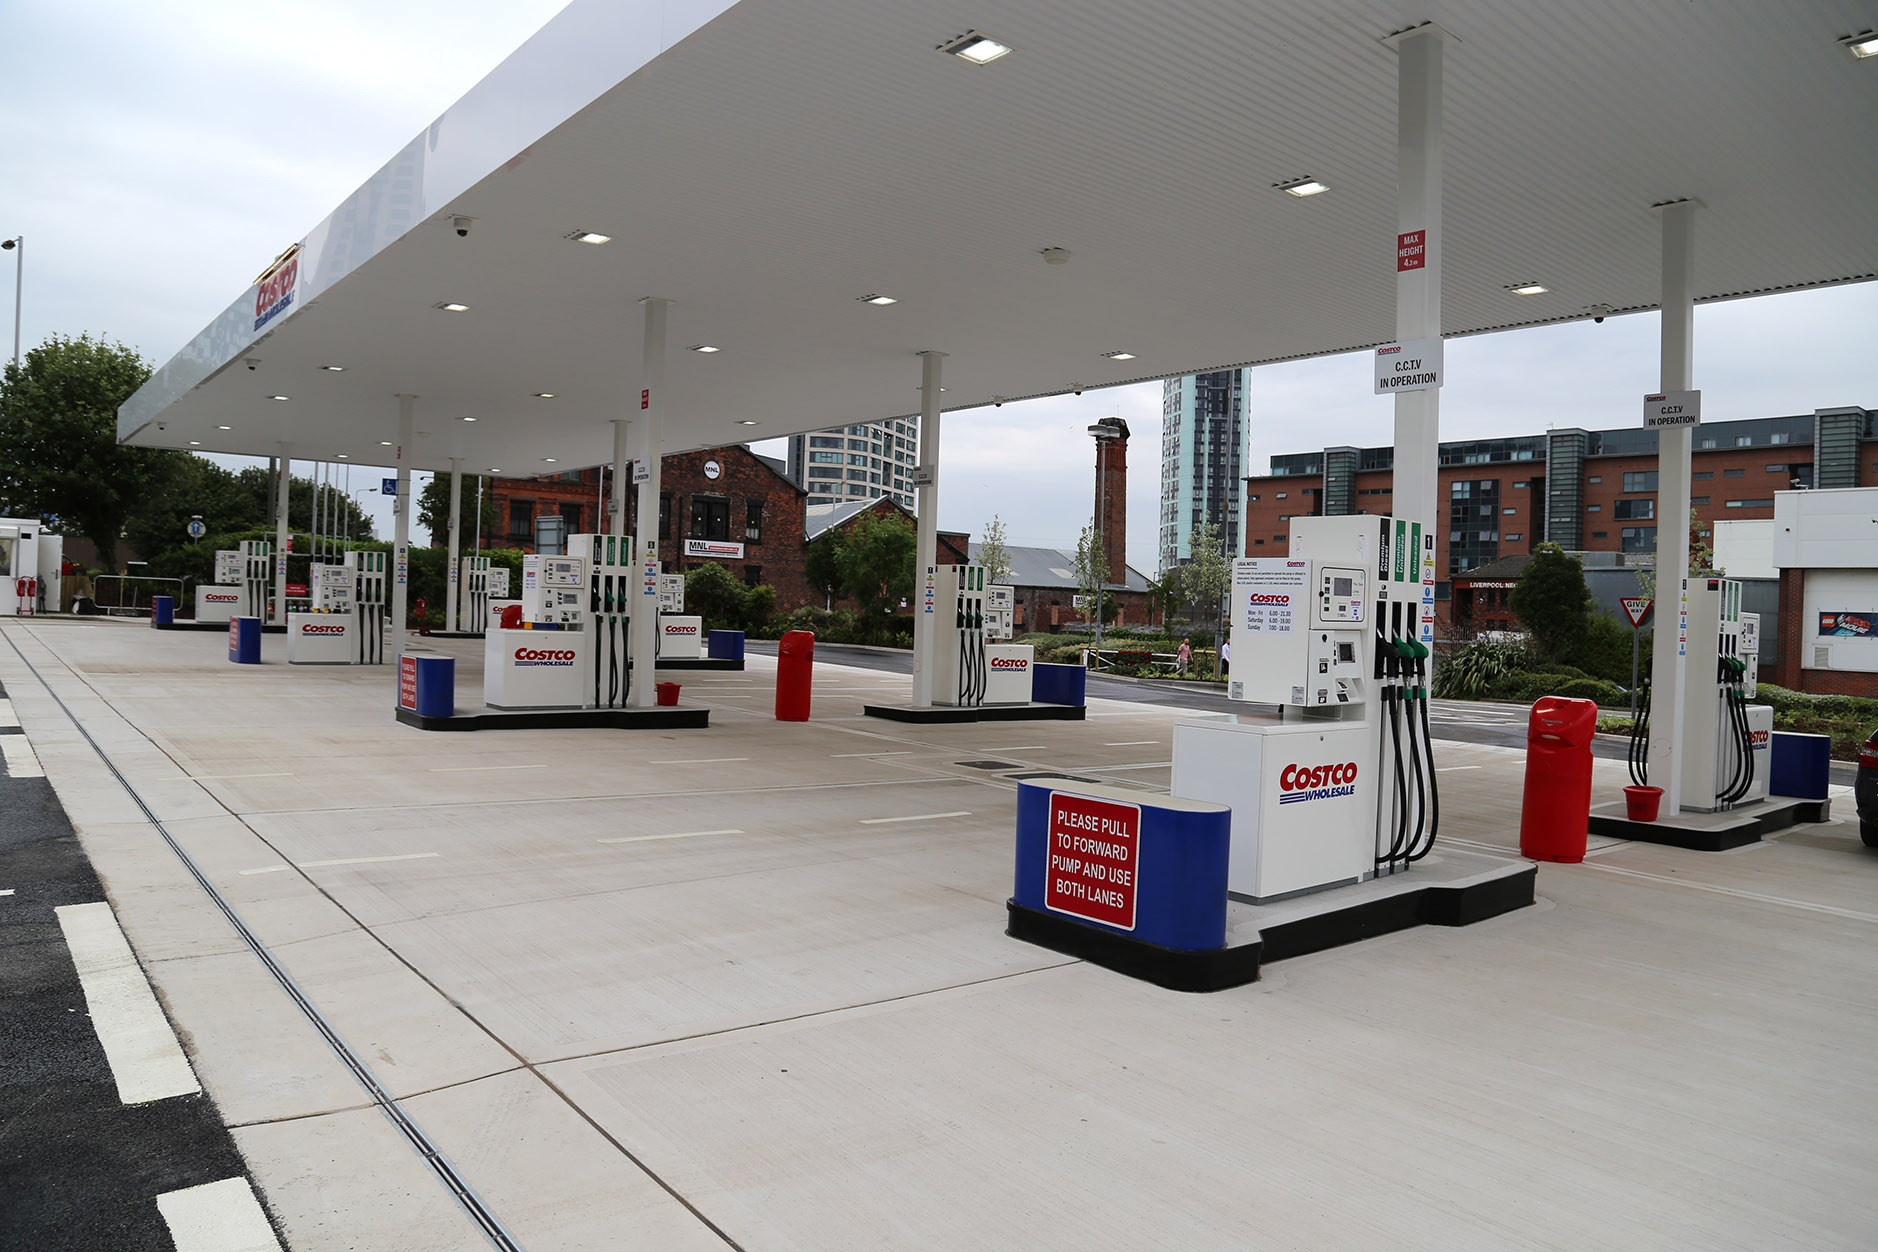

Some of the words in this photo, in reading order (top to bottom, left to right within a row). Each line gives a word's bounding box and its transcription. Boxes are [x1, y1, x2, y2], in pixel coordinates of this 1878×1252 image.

[1404, 234, 1419, 245] MAX
[1399, 245, 1424, 257] HEIGHT
[256, 259, 298, 317] COSTCO
[1378, 346, 1402, 354] COSTCO
[1380, 378, 1389, 388] IN
[1390, 372, 1437, 387] OPERATION
[1648, 418, 1656, 426] IN
[1657, 416, 1696, 425] OPERATION
[690, 541, 708, 550] MNL
[1250, 593, 1290, 603] COSTCO
[302, 624, 345, 632] COSTCO
[514, 647, 576, 660] COSTCO
[991, 657, 1028, 667] COSTCO
[1744, 730, 1769, 744] STCO
[1280, 762, 1358, 791] COSTCO
[1305, 785, 1355, 801] WHOLESALE
[1057, 810, 1099, 832] PLEASE
[1101, 818, 1130, 838] PULL
[1057, 832, 1071, 849] TO
[1073, 836, 1128, 861] FORWARD
[1051, 854, 1081, 874] PUMP
[1082, 861, 1106, 880] AND
[1108, 867, 1132, 886] USE
[1056, 878, 1085, 899] BOTH
[1087, 886, 1124, 909] LANES
